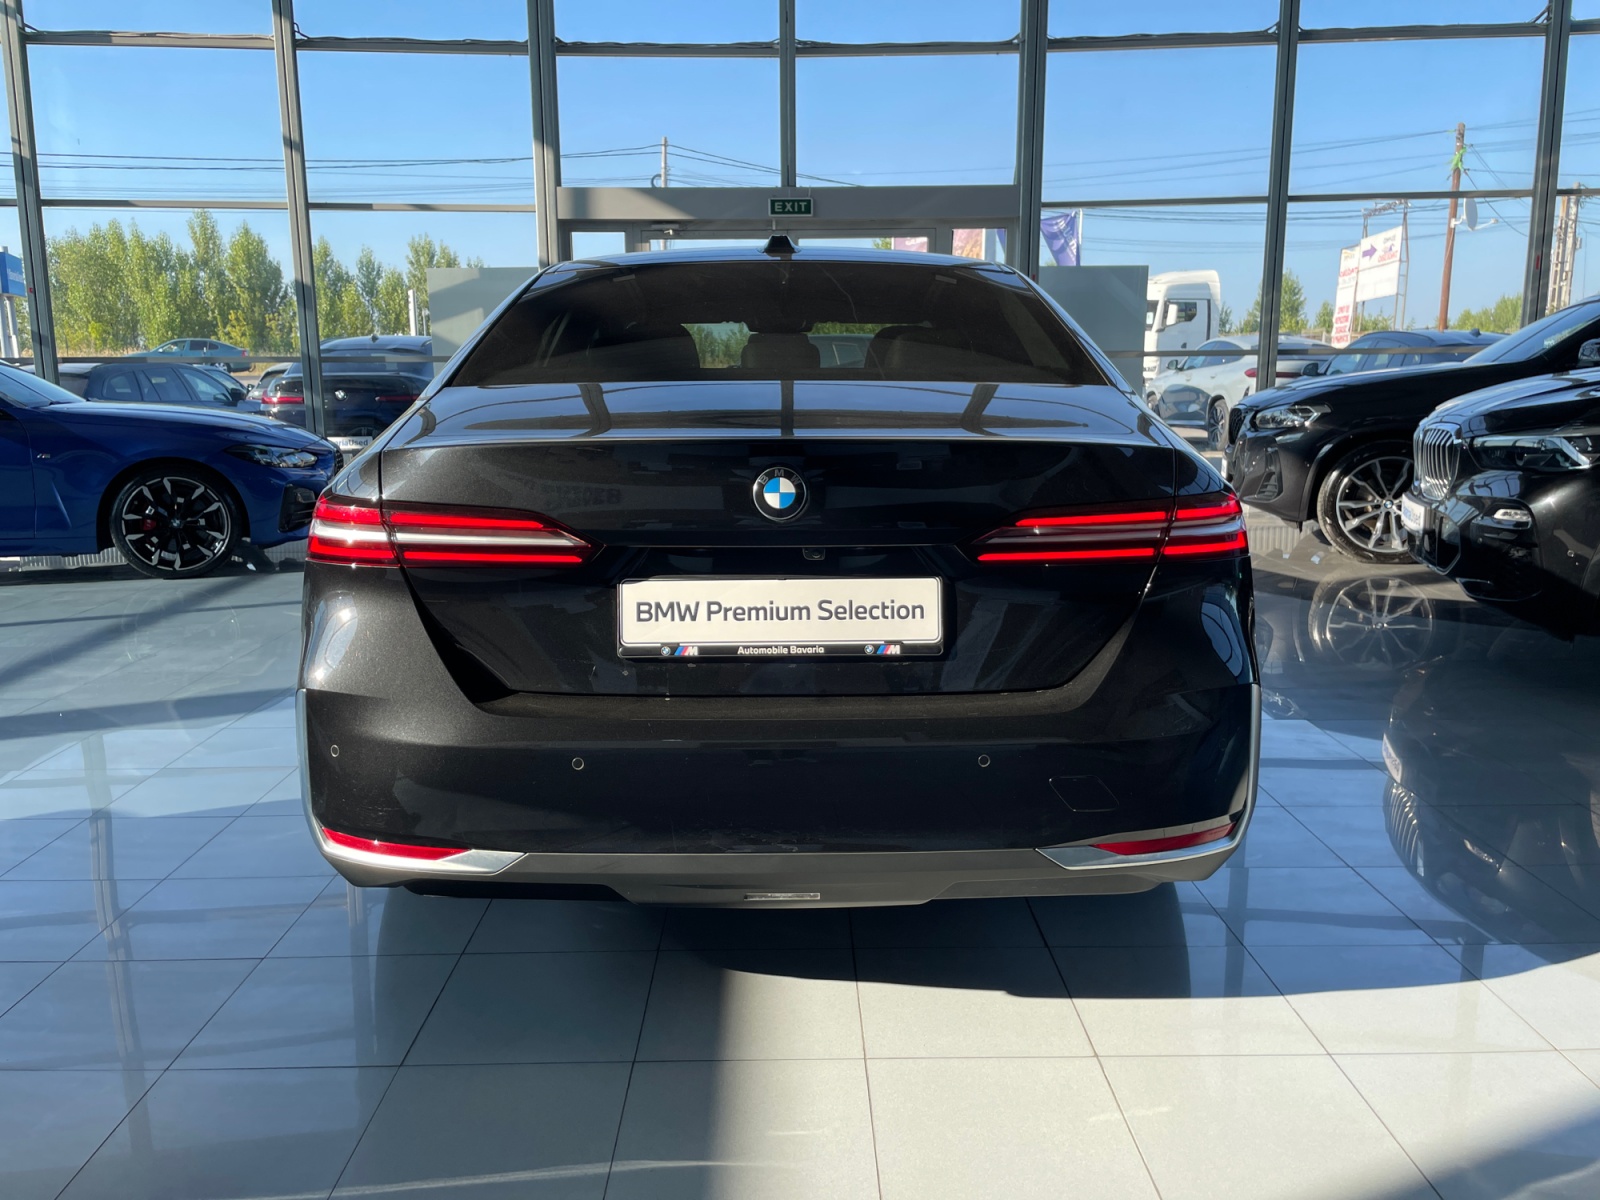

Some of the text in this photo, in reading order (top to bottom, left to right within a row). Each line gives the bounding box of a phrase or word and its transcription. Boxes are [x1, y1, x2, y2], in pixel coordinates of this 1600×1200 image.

[774, 202, 807, 212] EXIT
[758, 468, 803, 486] BMW
[635, 599, 925, 622] BMW Premium Selection
[737, 645, 825, 655] Automobile Bavaria
